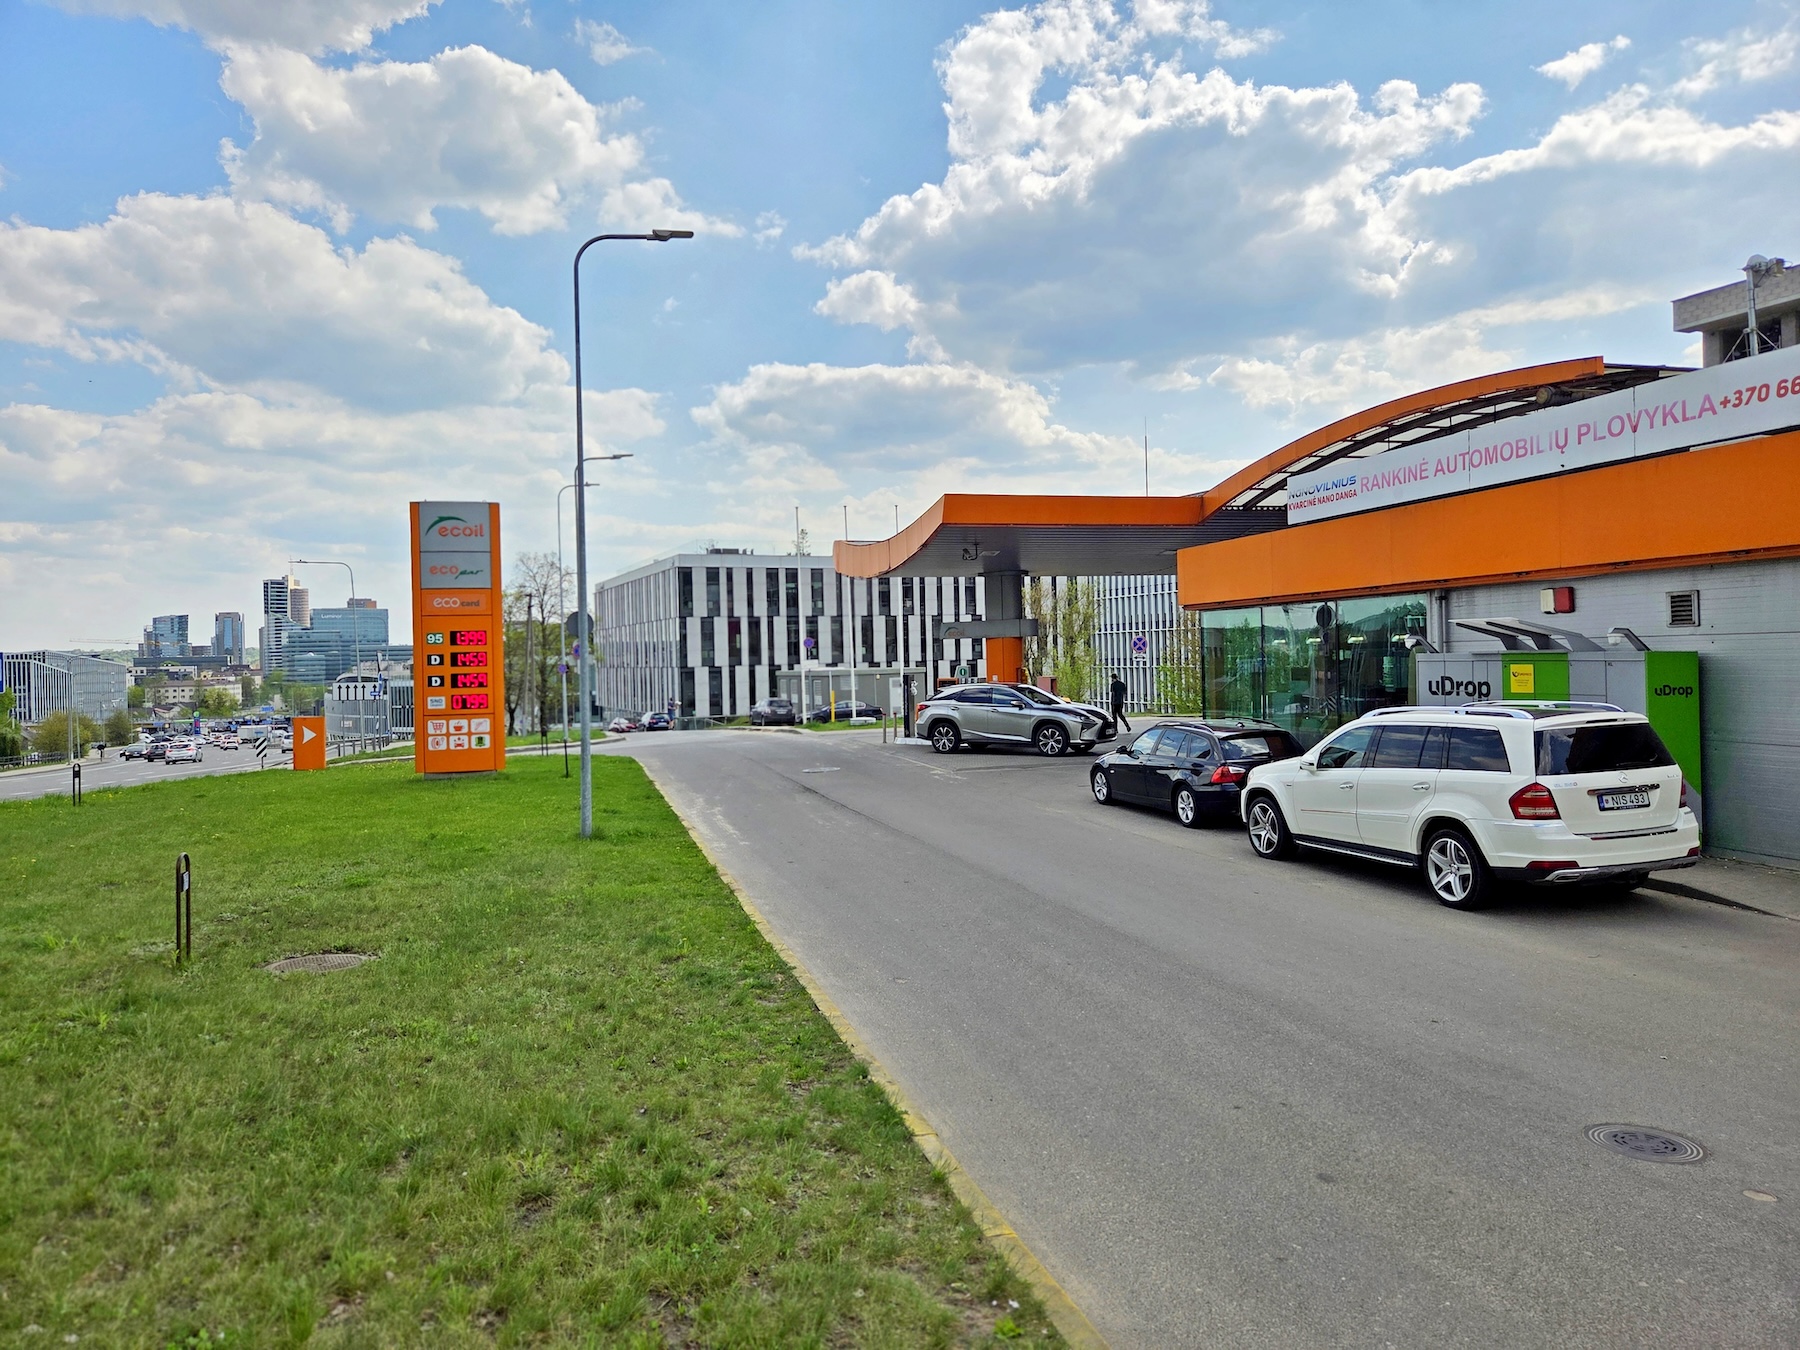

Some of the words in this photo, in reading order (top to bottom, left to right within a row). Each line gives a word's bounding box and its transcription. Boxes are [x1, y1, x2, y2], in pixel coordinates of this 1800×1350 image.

[1360, 457, 1429, 493] RANKINĖ
[1433, 427, 1569, 477] AUTOMOBILIŲ
[1577, 393, 1717, 445] PLOVYKLA
[1719, 383, 1770, 409] +370
[1317, 494, 1335, 504] NANO
[1335, 489, 1358, 501] DANGA
[438, 523, 485, 537] ecoil
[433, 597, 460, 608] eco
[427, 633, 444, 644] 95
[430, 655, 440, 665] D
[431, 676, 441, 687] D
[1428, 675, 1491, 702] uDrop
[1654, 684, 1693, 698] uDrop
[1611, 793, 1628, 806] NIS
[1629, 792, 1646, 805] 493
